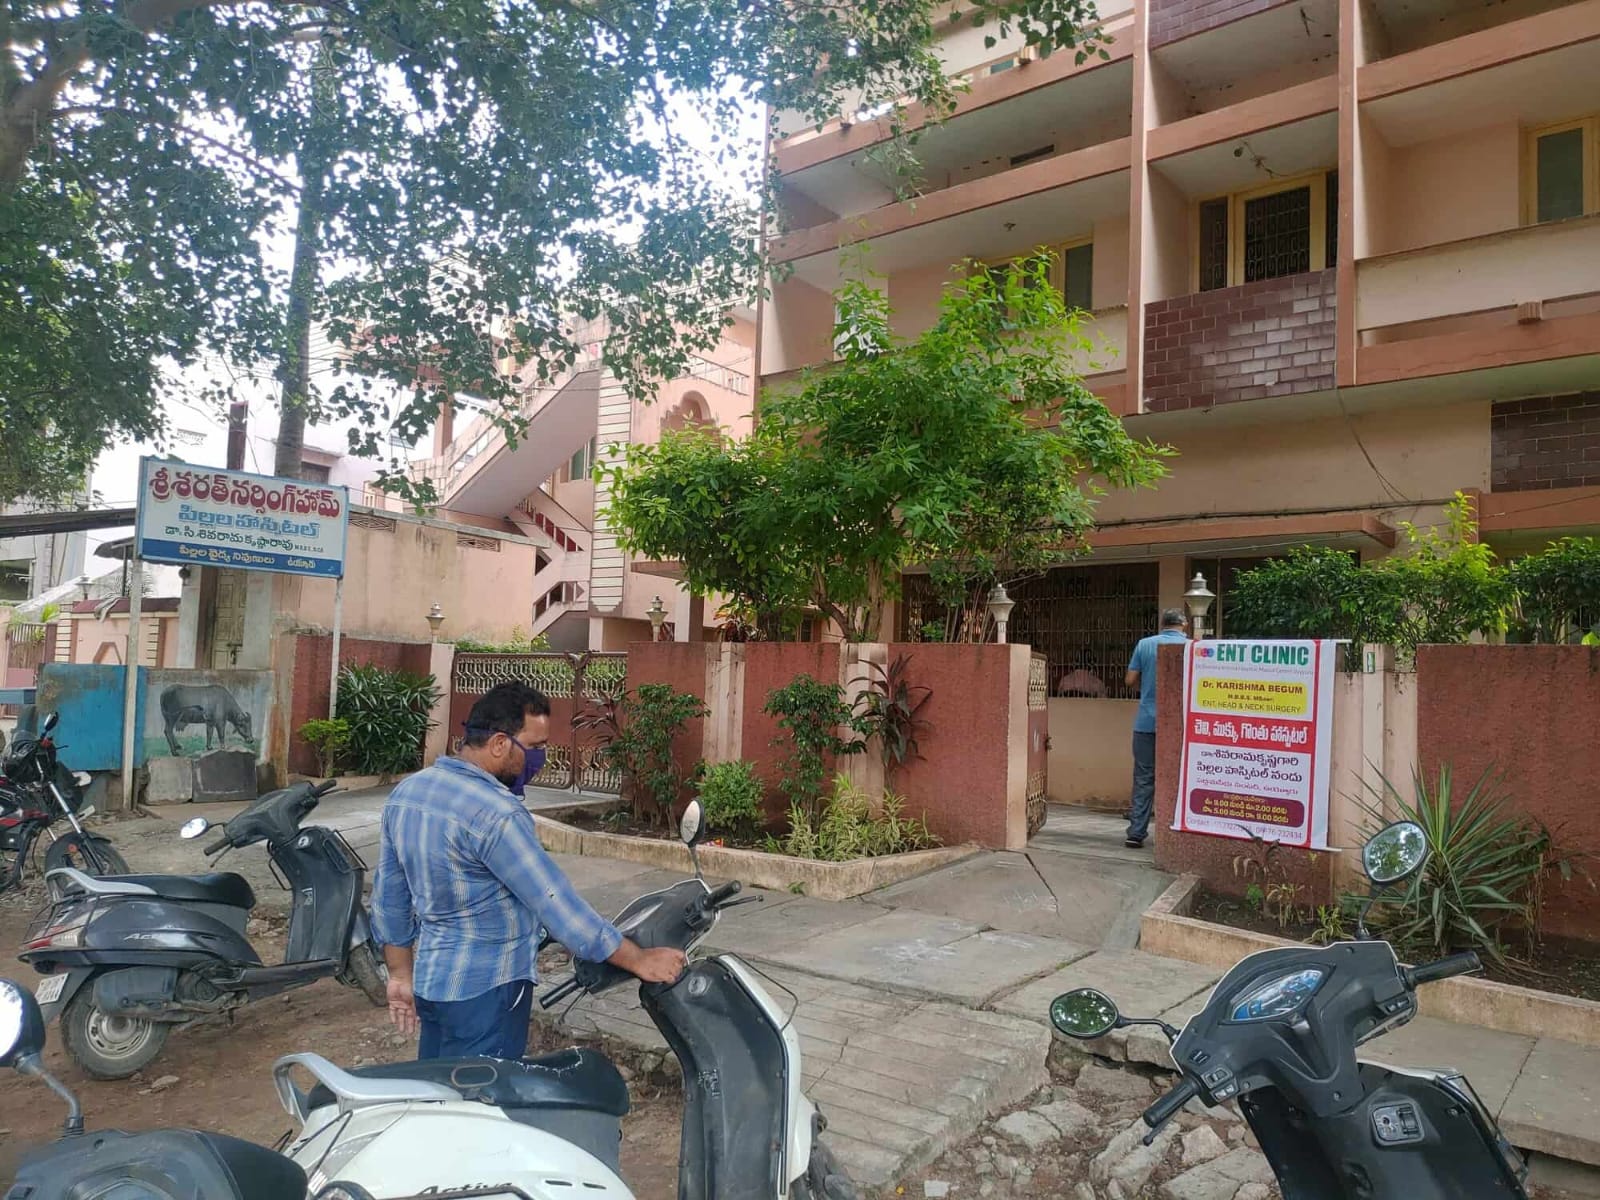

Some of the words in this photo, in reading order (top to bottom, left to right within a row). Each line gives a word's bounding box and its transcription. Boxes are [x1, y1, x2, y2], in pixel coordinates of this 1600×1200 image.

[178, 503, 233, 529] పిల్లల
[1216, 643, 1247, 662] ENT
[1251, 645, 1309, 666] CLINIC
[1202, 680, 1214, 688] Dr.
[1216, 681, 1266, 692] KARISHMA
[1268, 685, 1303, 694] BEGUM
[1217, 701, 1237, 709] HEAD
[1245, 702, 1266, 711] NECK
[1267, 704, 1301, 713] SURGERY
[1197, 761, 1223, 775] పిల్లల
[1271, 770, 1302, 782] నందు
